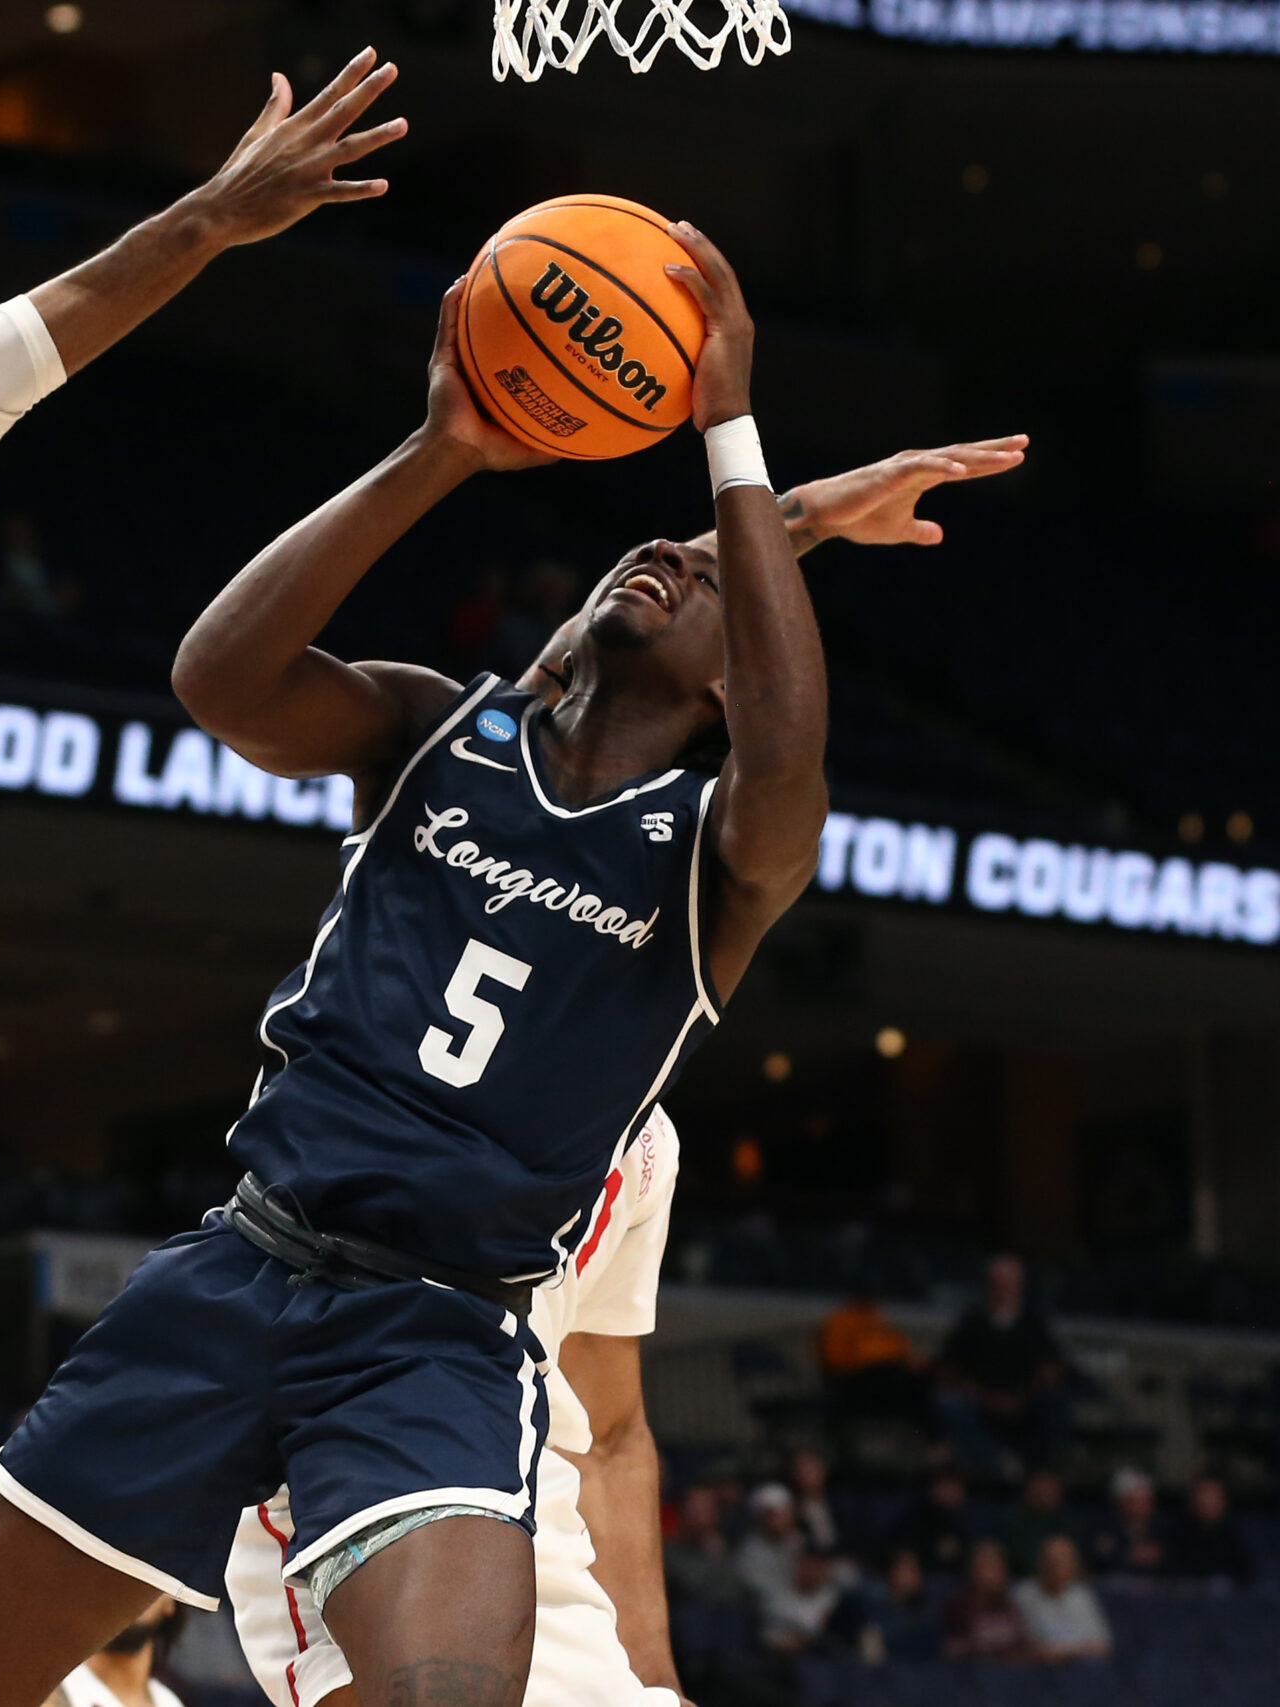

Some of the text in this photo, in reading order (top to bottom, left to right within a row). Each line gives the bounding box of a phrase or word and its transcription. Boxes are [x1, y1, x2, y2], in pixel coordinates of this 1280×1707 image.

[531, 261, 667, 412] Wilson
[565, 343, 609, 383] EVO NXT
[515, 391, 576, 436] MADNESS
[518, 379, 564, 419] MARCH
[414, 802, 660, 949] Longwood
[966, 831, 1280, 945] COUGARS
[418, 938, 533, 1089] 5
